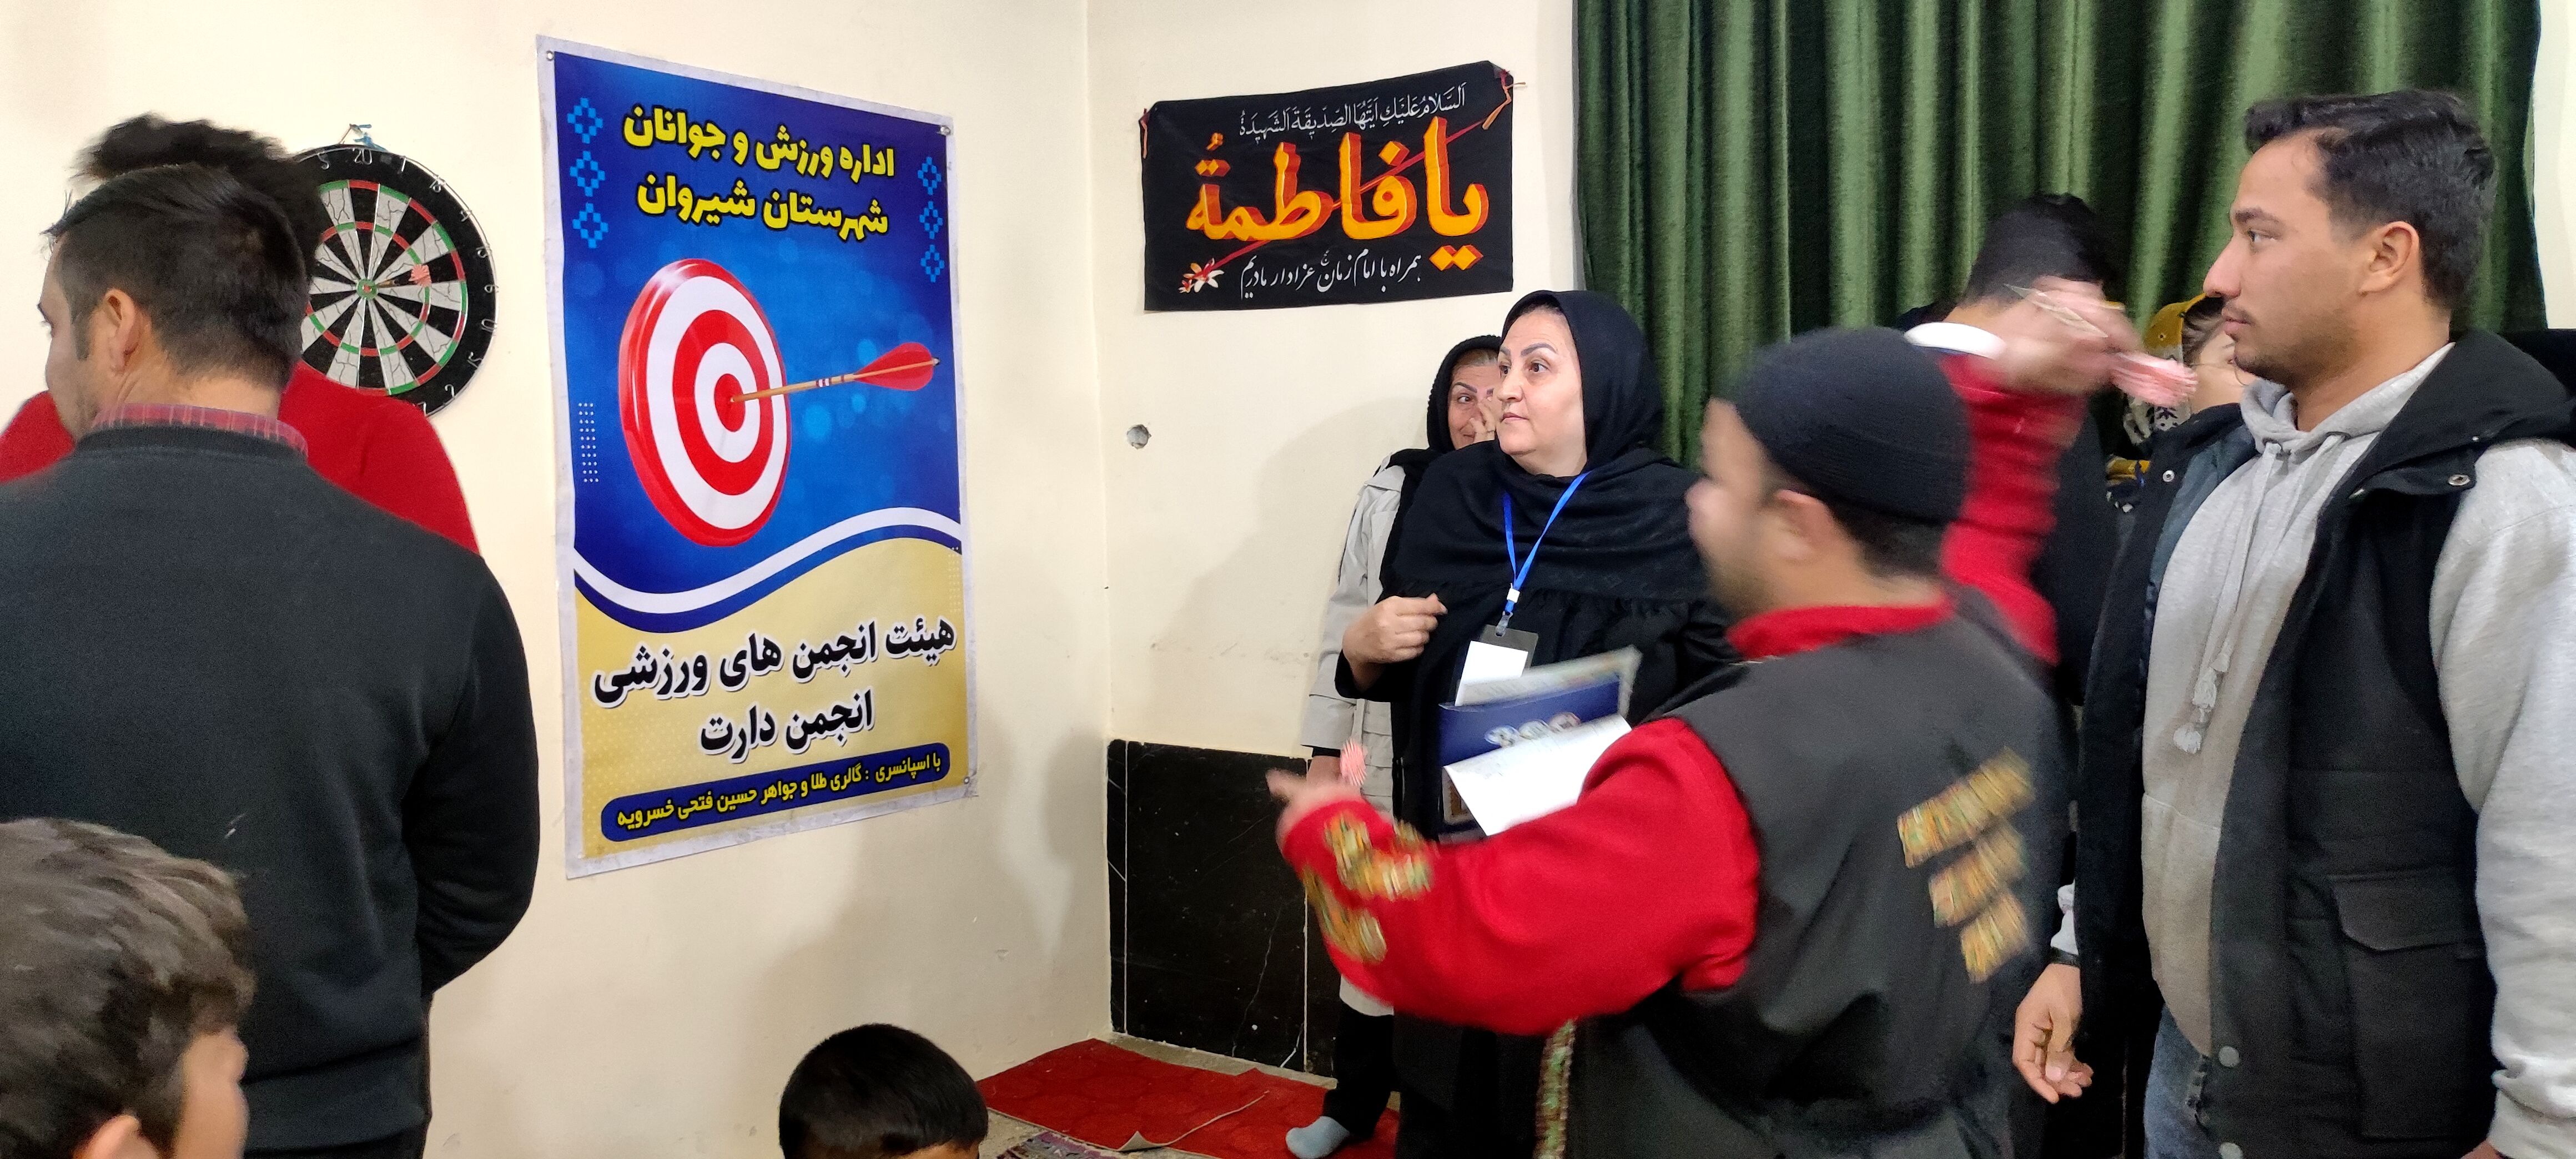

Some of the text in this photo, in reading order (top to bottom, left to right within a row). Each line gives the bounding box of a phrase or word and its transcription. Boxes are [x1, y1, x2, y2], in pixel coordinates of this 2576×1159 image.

[352, 148, 373, 165] 20
[623, 106, 895, 183] اداره ورزش و جوانان
[638, 174, 888, 241] شهرستان شیروان
[1354, 248, 1375, 286] امام
[1380, 257, 1387, 293] با
[1389, 254, 1422, 283] همراه
[595, 618, 955, 703] هیئت انجمن های ورزشی
[701, 691, 873, 761] انجمن دارت
[876, 755, 930, 783] اسپانسری
[933, 752, 941, 772] با
[801, 780, 808, 797] و
[811, 772, 827, 790] طلا
[831, 763, 862, 791] گالری
[678, 791, 713, 820] فتحی
[717, 790, 757, 812] حسین
[761, 781, 798, 804] جواهر
